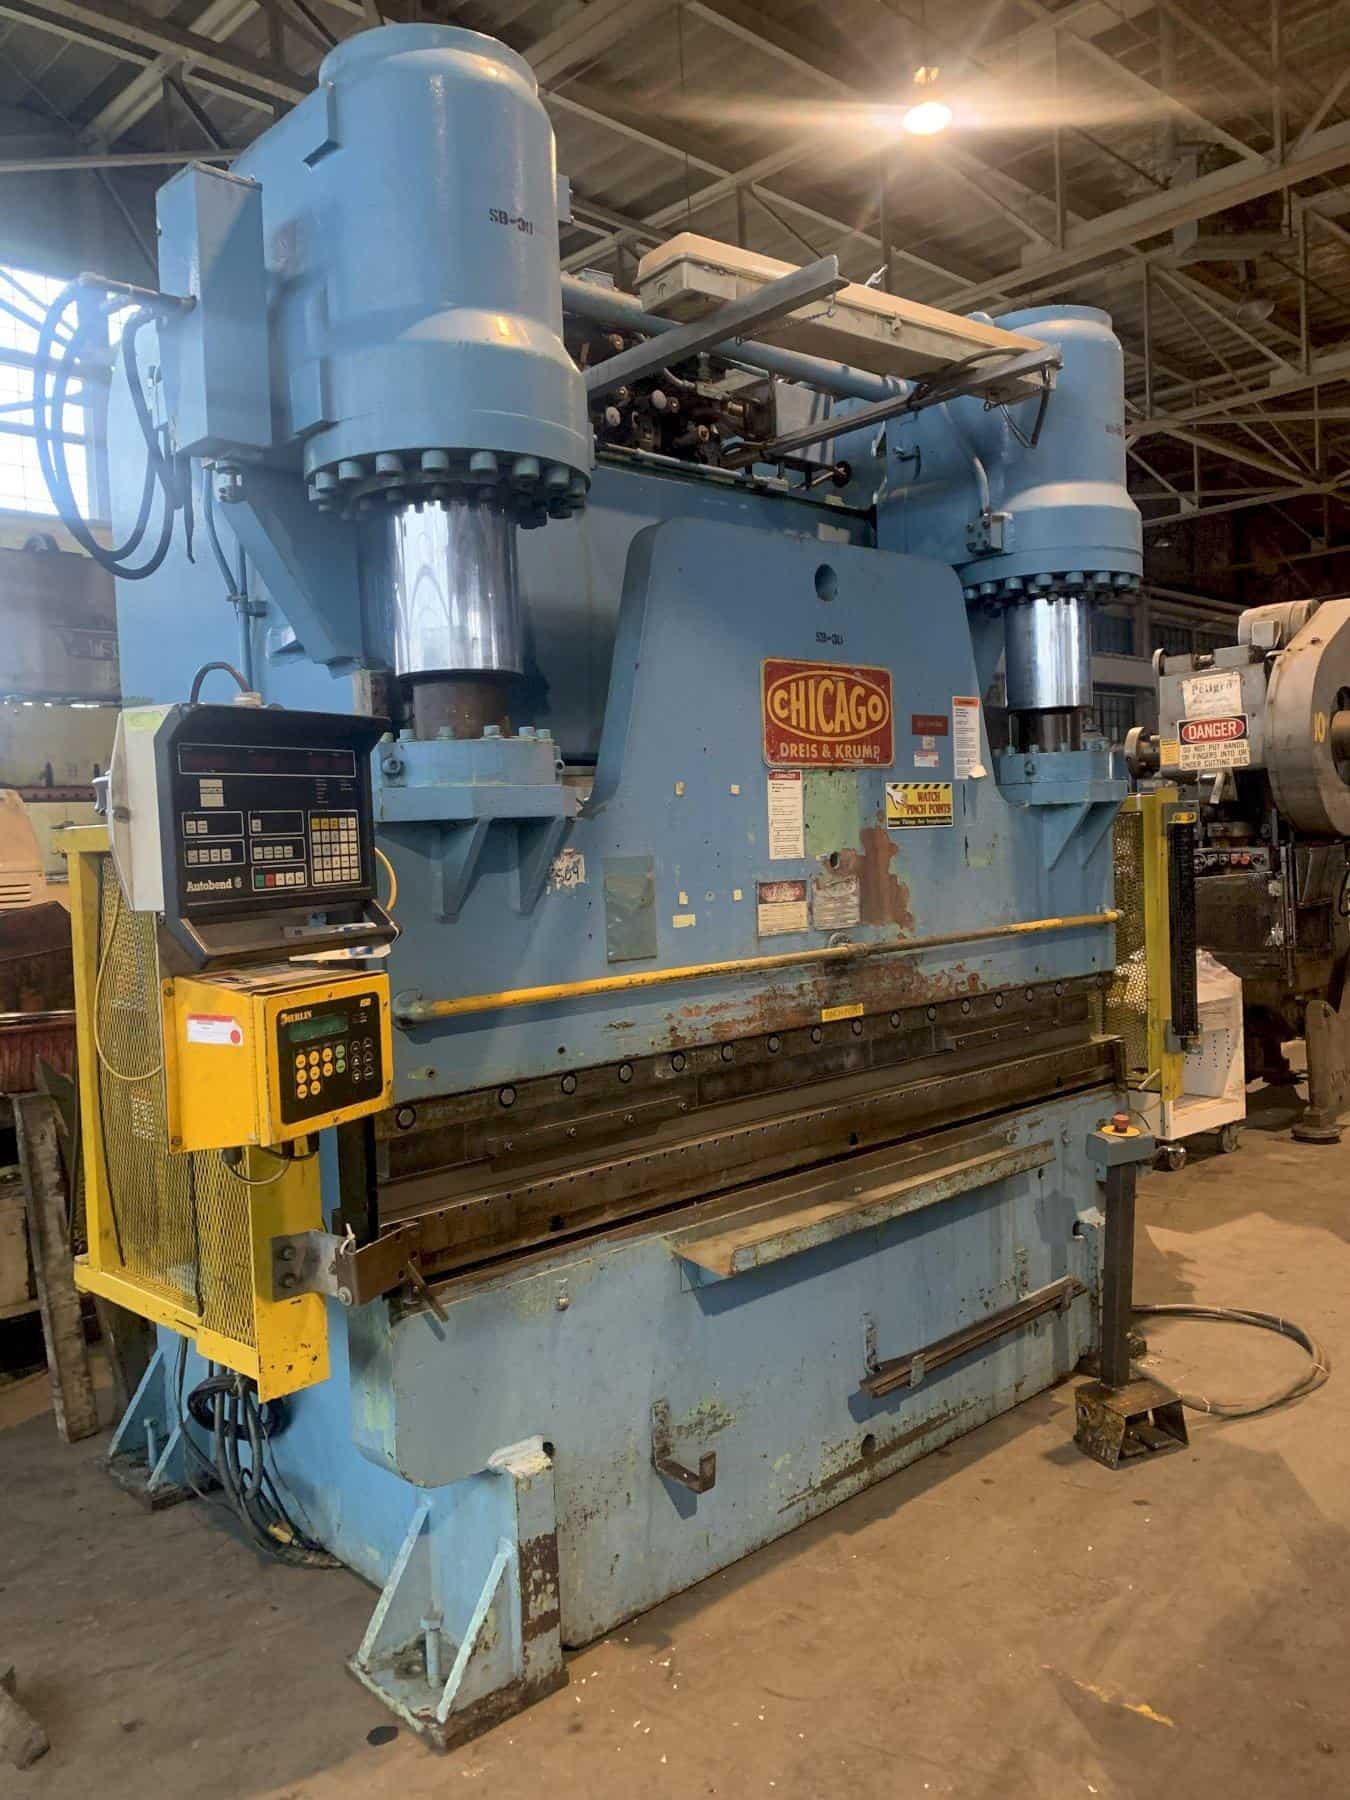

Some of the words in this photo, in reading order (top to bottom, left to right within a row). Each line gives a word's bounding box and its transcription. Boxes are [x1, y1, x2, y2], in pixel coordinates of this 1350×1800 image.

[773, 678, 883, 733] CHICAGO
[1188, 721, 1237, 740] DANGER
[780, 742, 818, 758] DREIS
[822, 743, 831, 758] &
[835, 744, 881, 760] KRUMP
[1209, 743, 1220, 751] PUT
[1224, 741, 1245, 749] HANDS
[1193, 752, 1217, 760] FINGERS
[1220, 750, 1235, 758] INTO
[1182, 760, 1201, 769] UNDER
[1204, 759, 1230, 767] CUTTING
[917, 791, 941, 802] WATCH
[905, 804, 927, 815] PINCH
[928, 803, 952, 814] POINTS
[186, 878, 233, 892] Autobend
